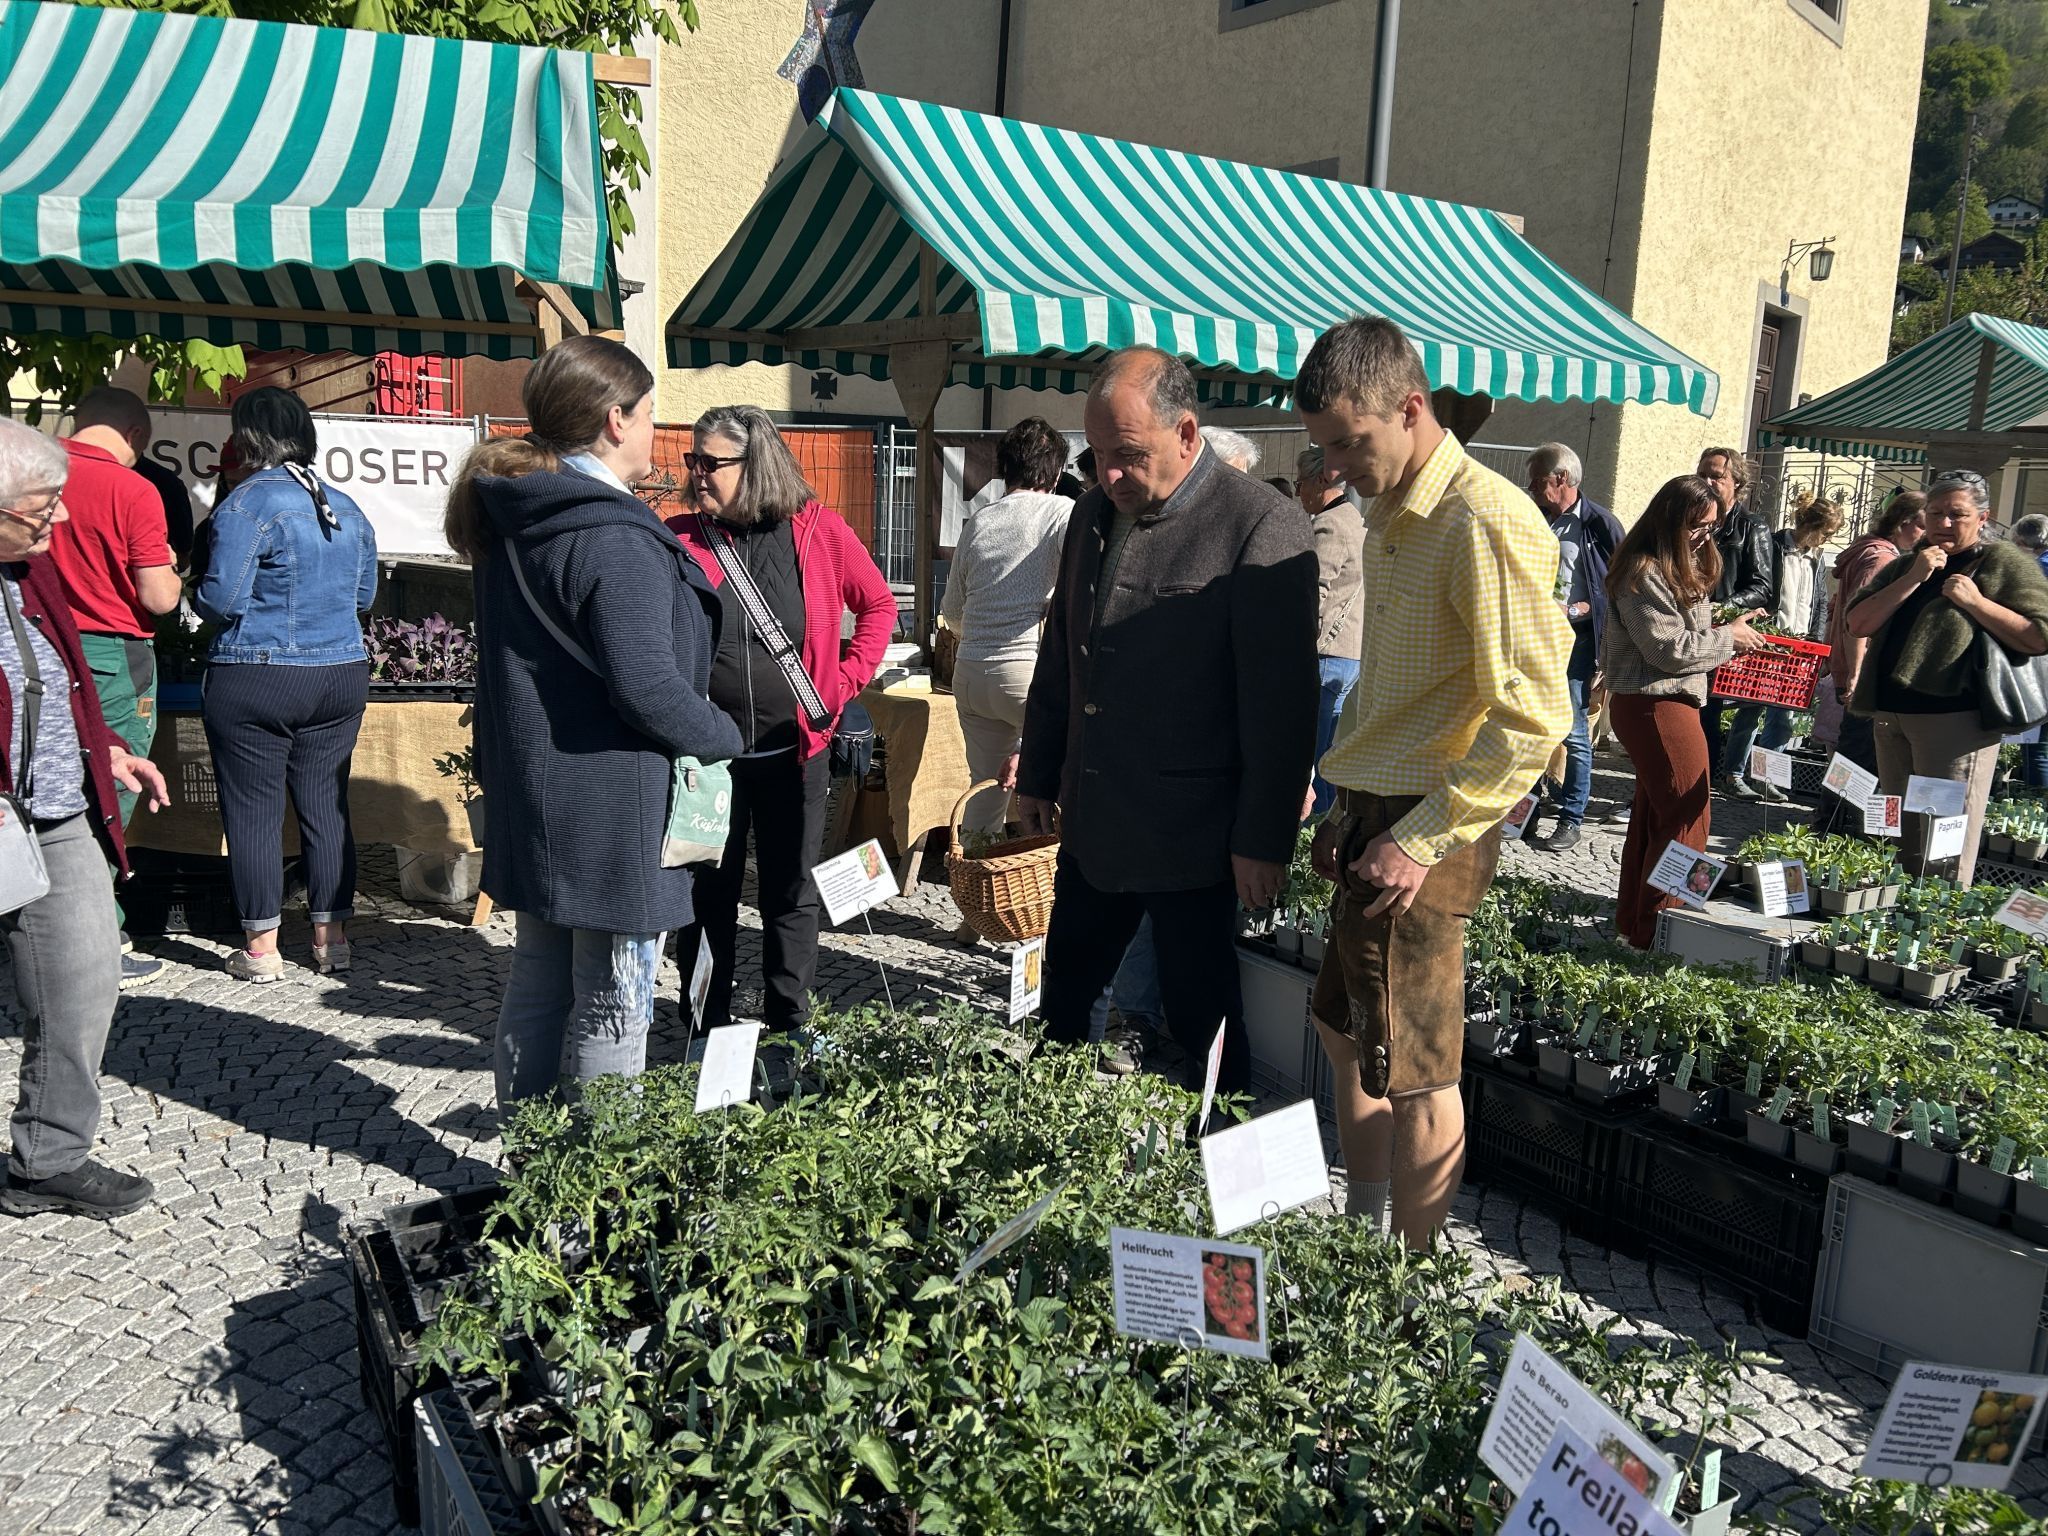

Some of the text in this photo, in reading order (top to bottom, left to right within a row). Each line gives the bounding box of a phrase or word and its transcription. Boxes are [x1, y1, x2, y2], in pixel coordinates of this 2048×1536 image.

[1938, 820, 1963, 833] Paprika
[1521, 1359, 1569, 1409] De Berao
[1912, 1368, 2000, 1388] Goldene Königin
[1528, 1497, 1569, 1536] to
